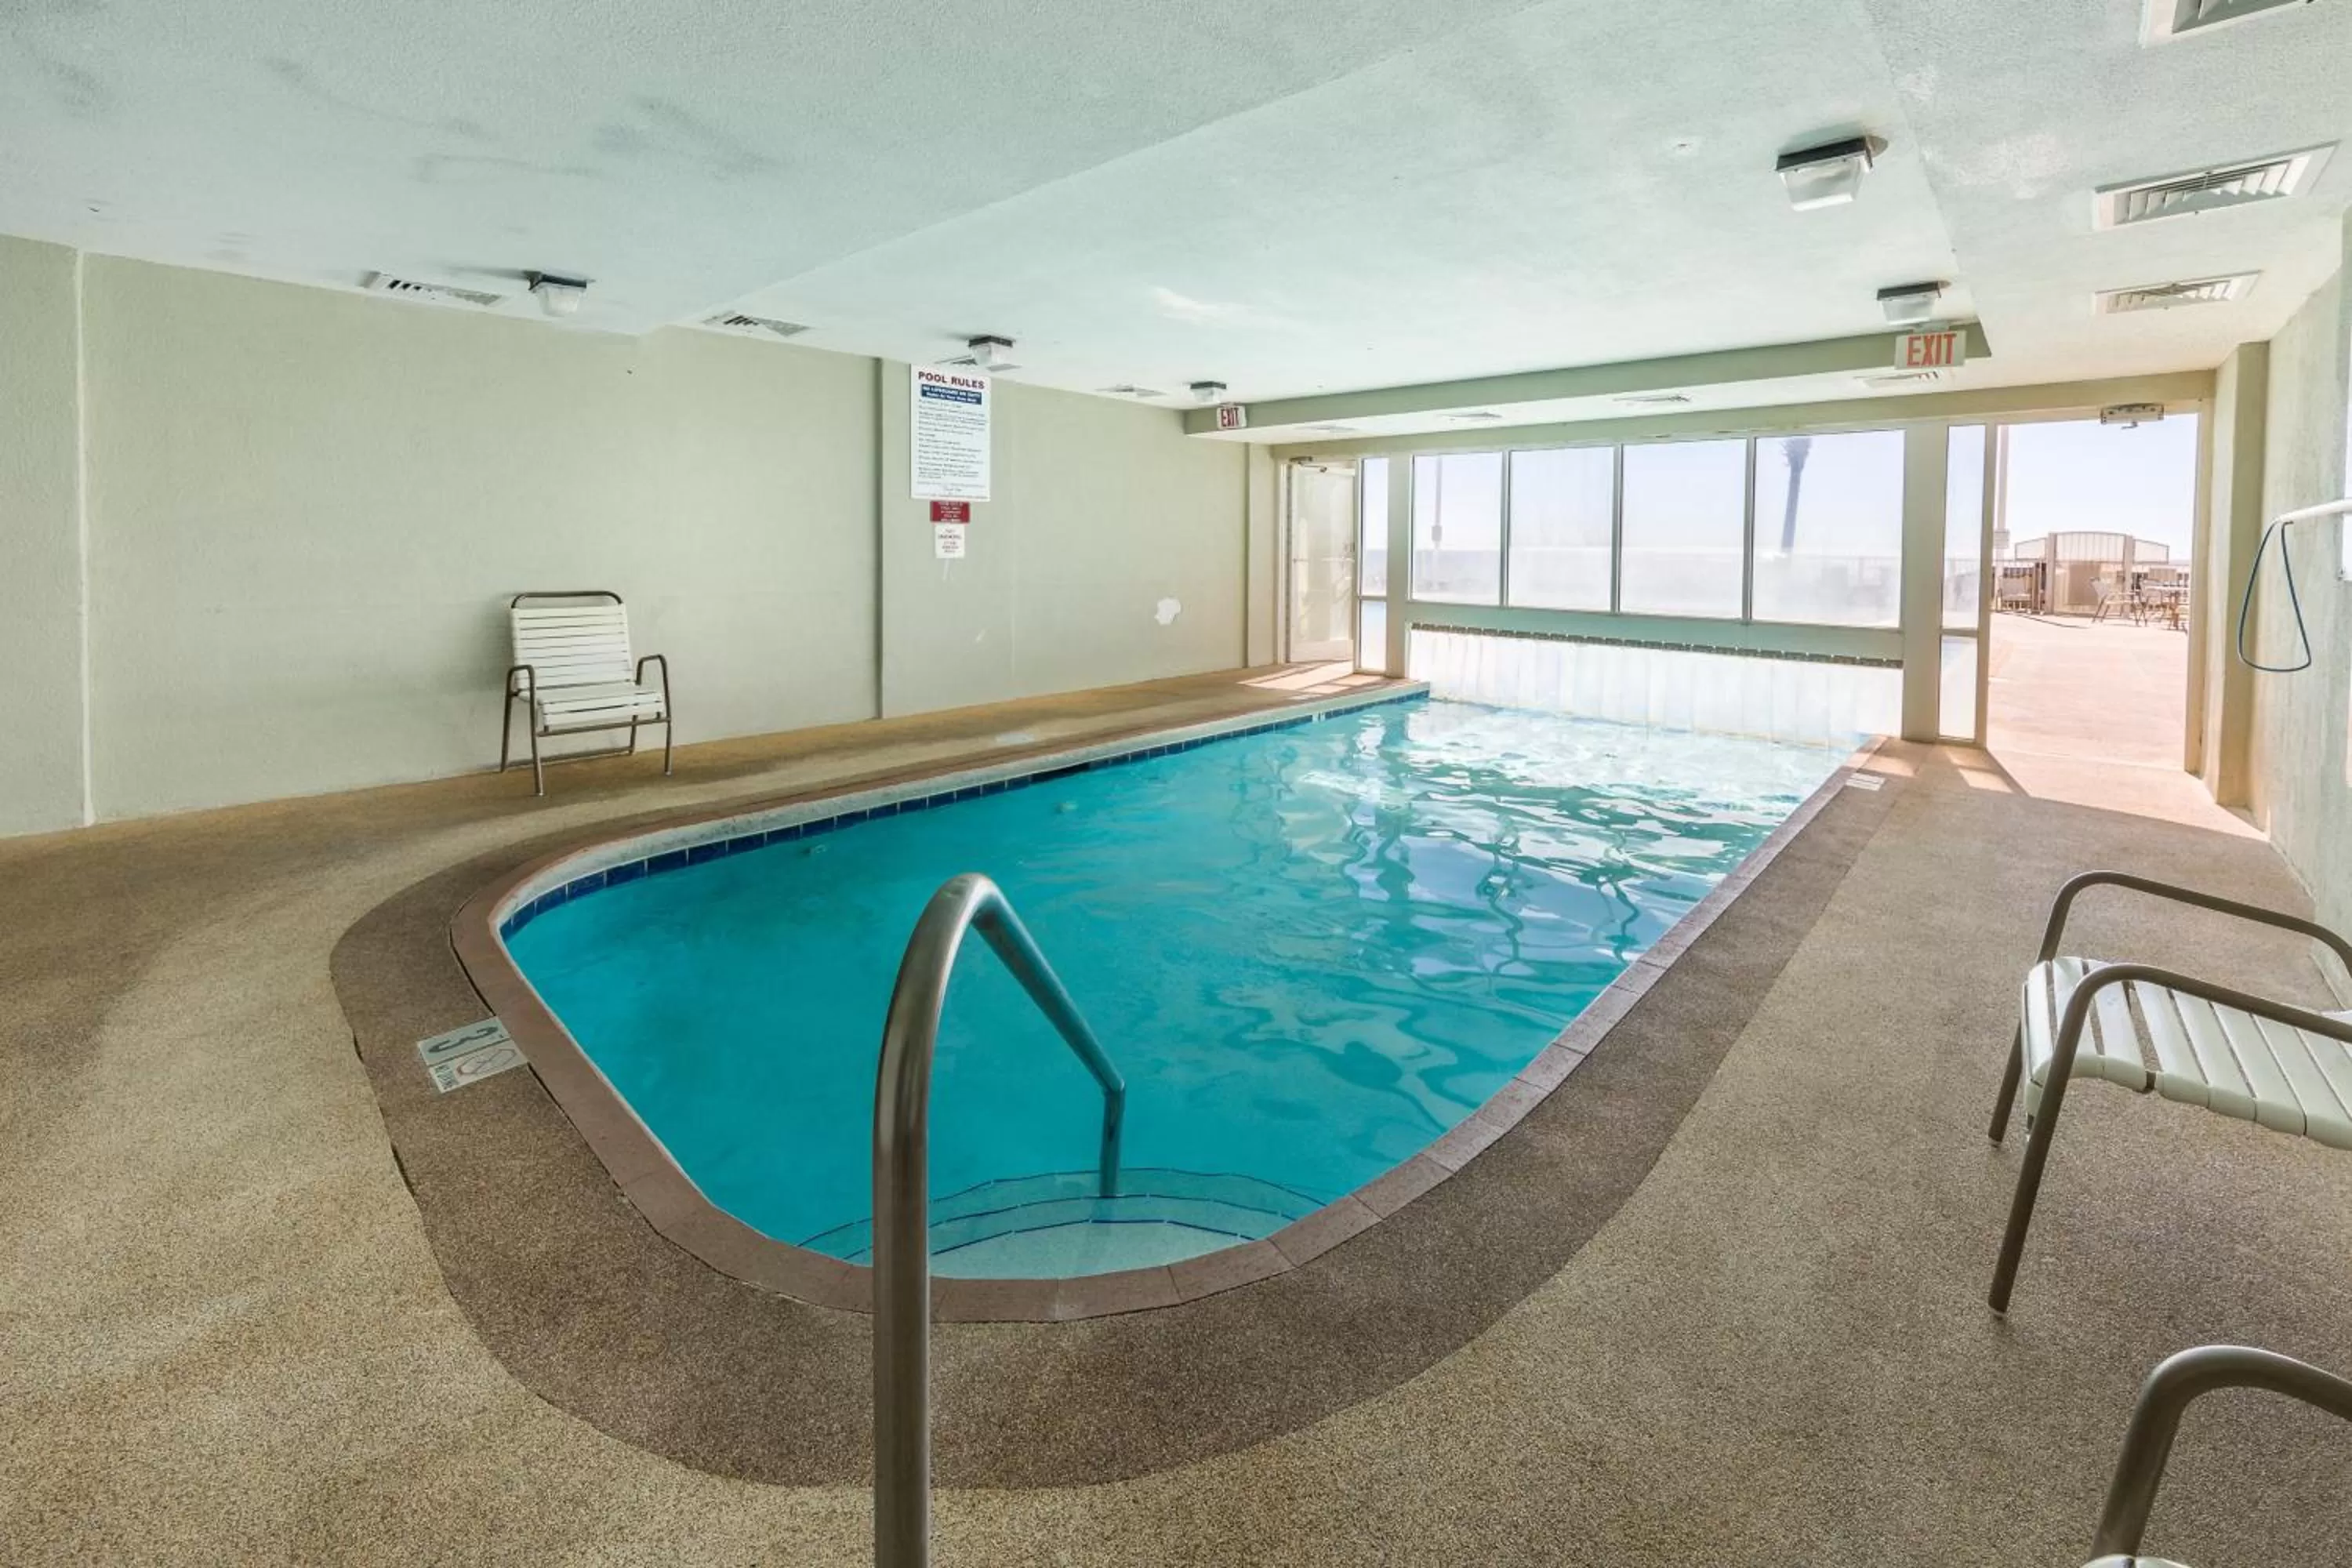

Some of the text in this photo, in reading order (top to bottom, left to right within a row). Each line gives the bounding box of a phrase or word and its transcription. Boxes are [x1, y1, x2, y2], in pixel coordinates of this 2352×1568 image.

[1907, 333, 1957, 366] EXIT
[918, 371, 985, 389] POOL RULES
[1220, 407, 1240, 427] EXIT
